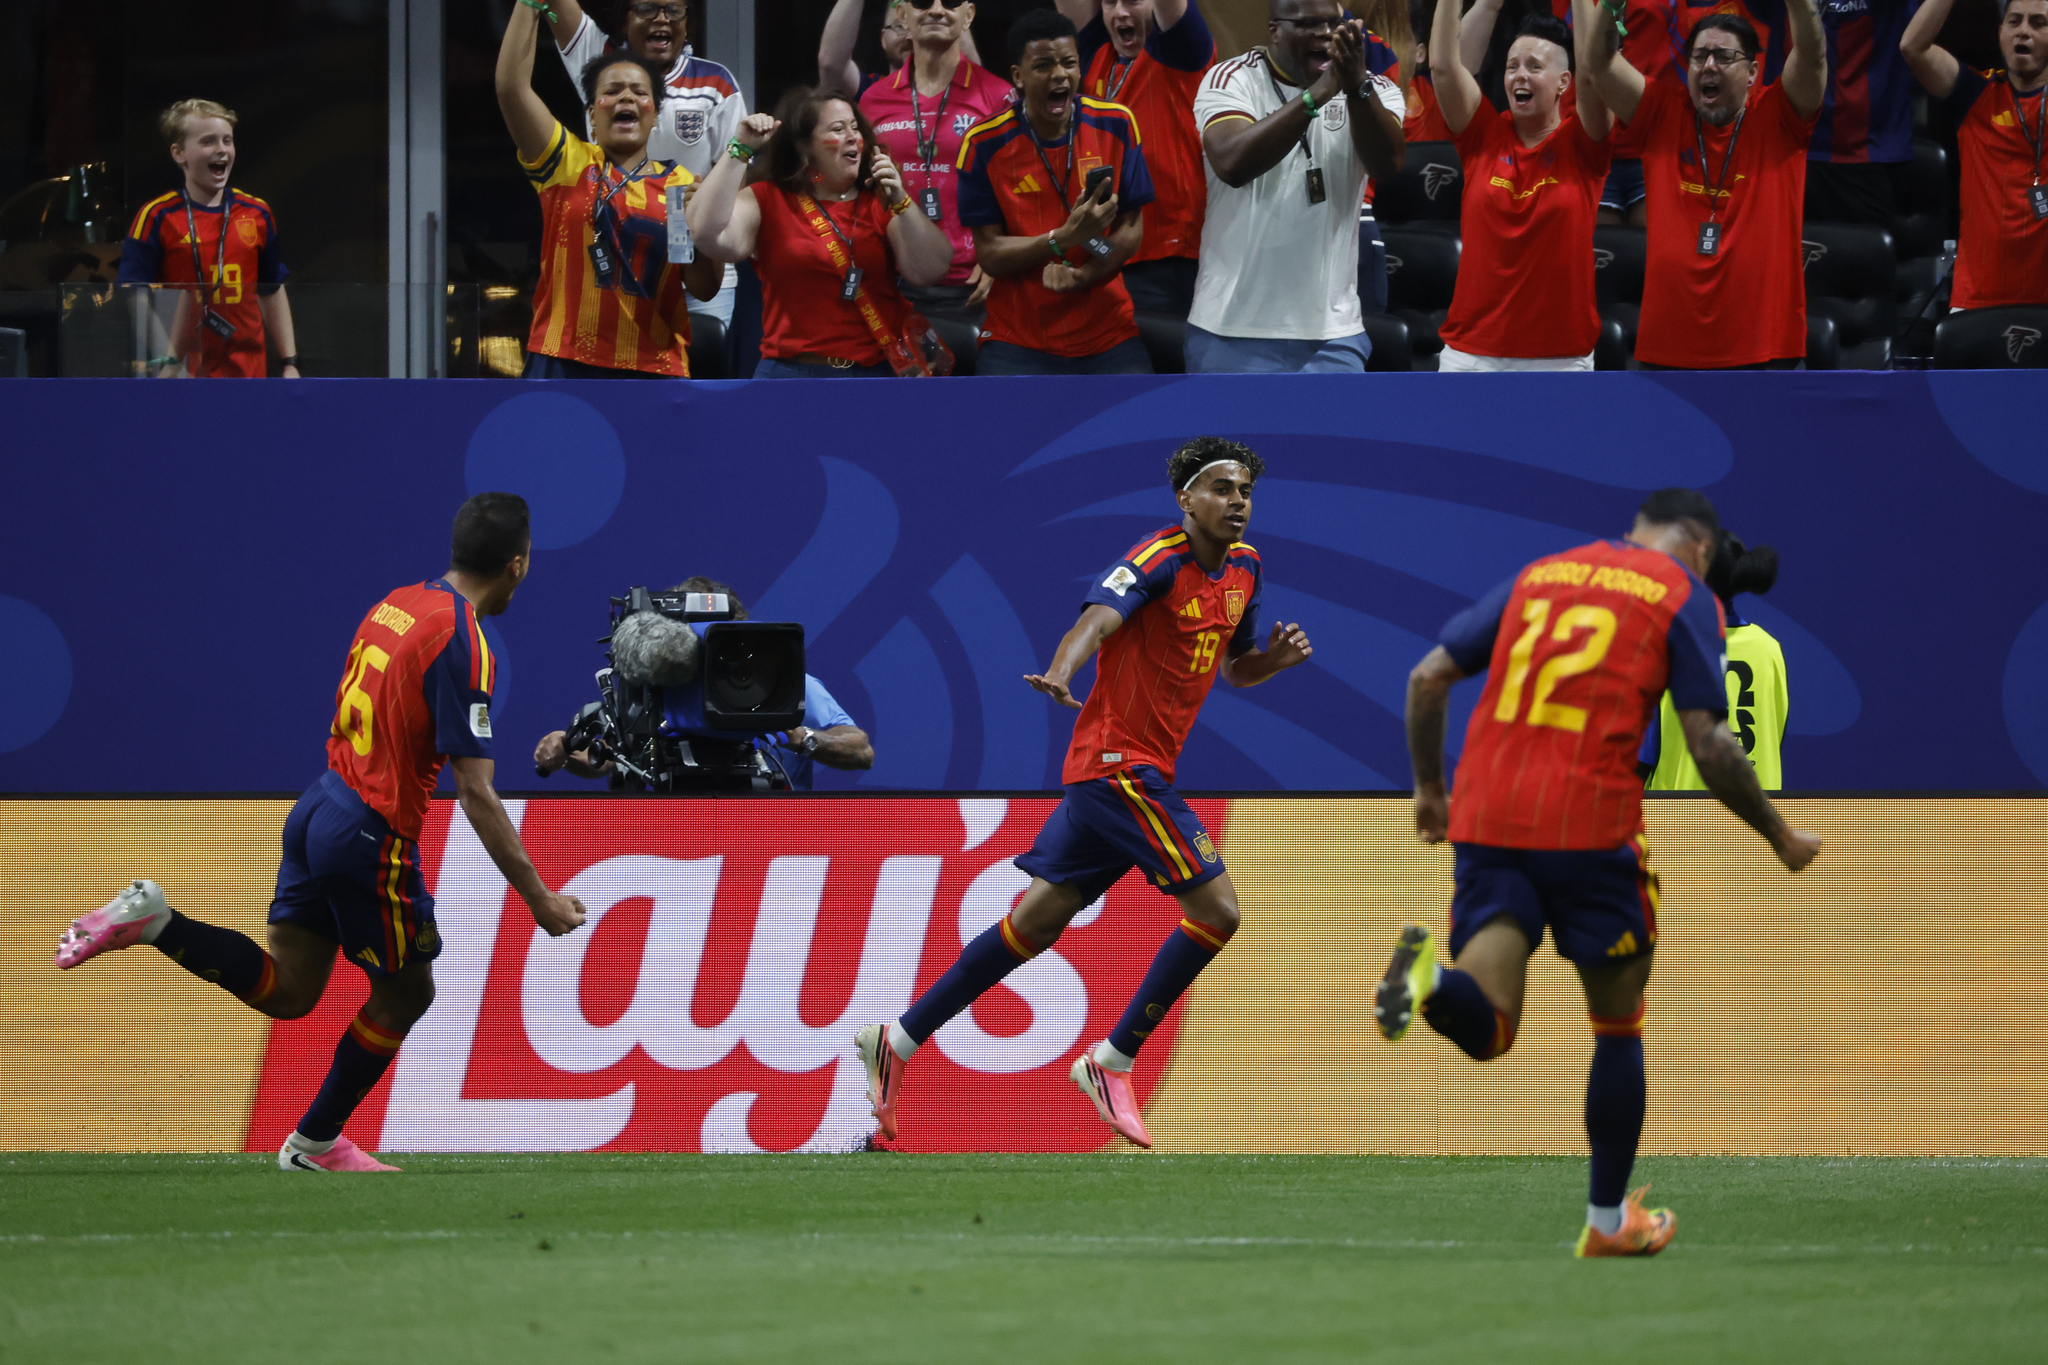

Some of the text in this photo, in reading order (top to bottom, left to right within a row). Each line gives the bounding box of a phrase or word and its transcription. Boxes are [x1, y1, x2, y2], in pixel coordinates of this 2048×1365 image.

[903, 162, 950, 173] BC.GAME
[826, 240, 848, 268] SPAIN
[209, 263, 242, 304] 19
[860, 303, 883, 332] SPAIN
[1589, 566, 1668, 605] PORRO
[371, 602, 416, 637] RODRIGO
[1190, 631, 1221, 674] 19
[1494, 597, 1618, 733] 12
[379, 799, 1104, 1153] Lay's
